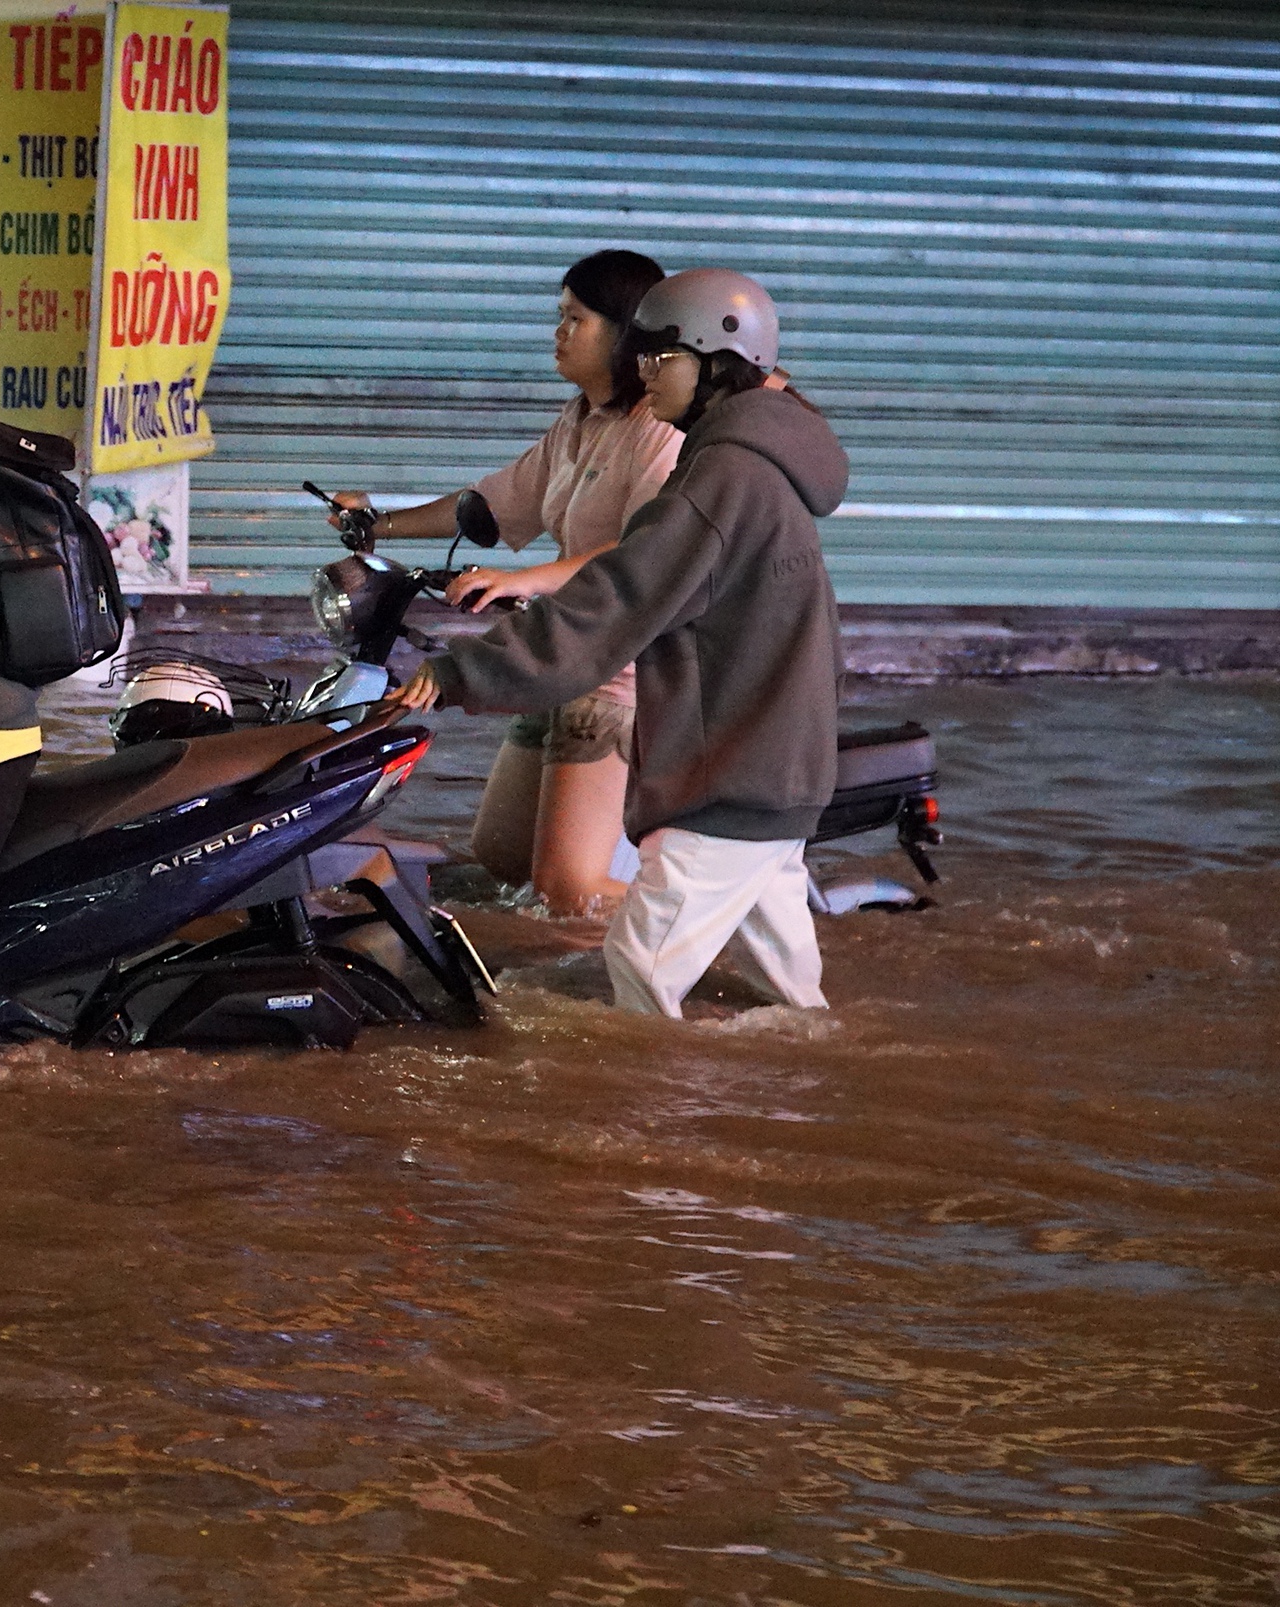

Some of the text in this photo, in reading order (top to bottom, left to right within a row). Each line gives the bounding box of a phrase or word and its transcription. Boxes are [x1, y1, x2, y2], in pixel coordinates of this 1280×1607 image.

[9, 5, 105, 91] TIẾP
[121, 20, 220, 115] CHÁO
[19, 134, 67, 188] THỊT
[0, 212, 59, 255] CHIM
[18, 275, 59, 331] ẾCH
[3, 366, 48, 409] RAU
[150, 802, 312, 876] AIRBLADE
